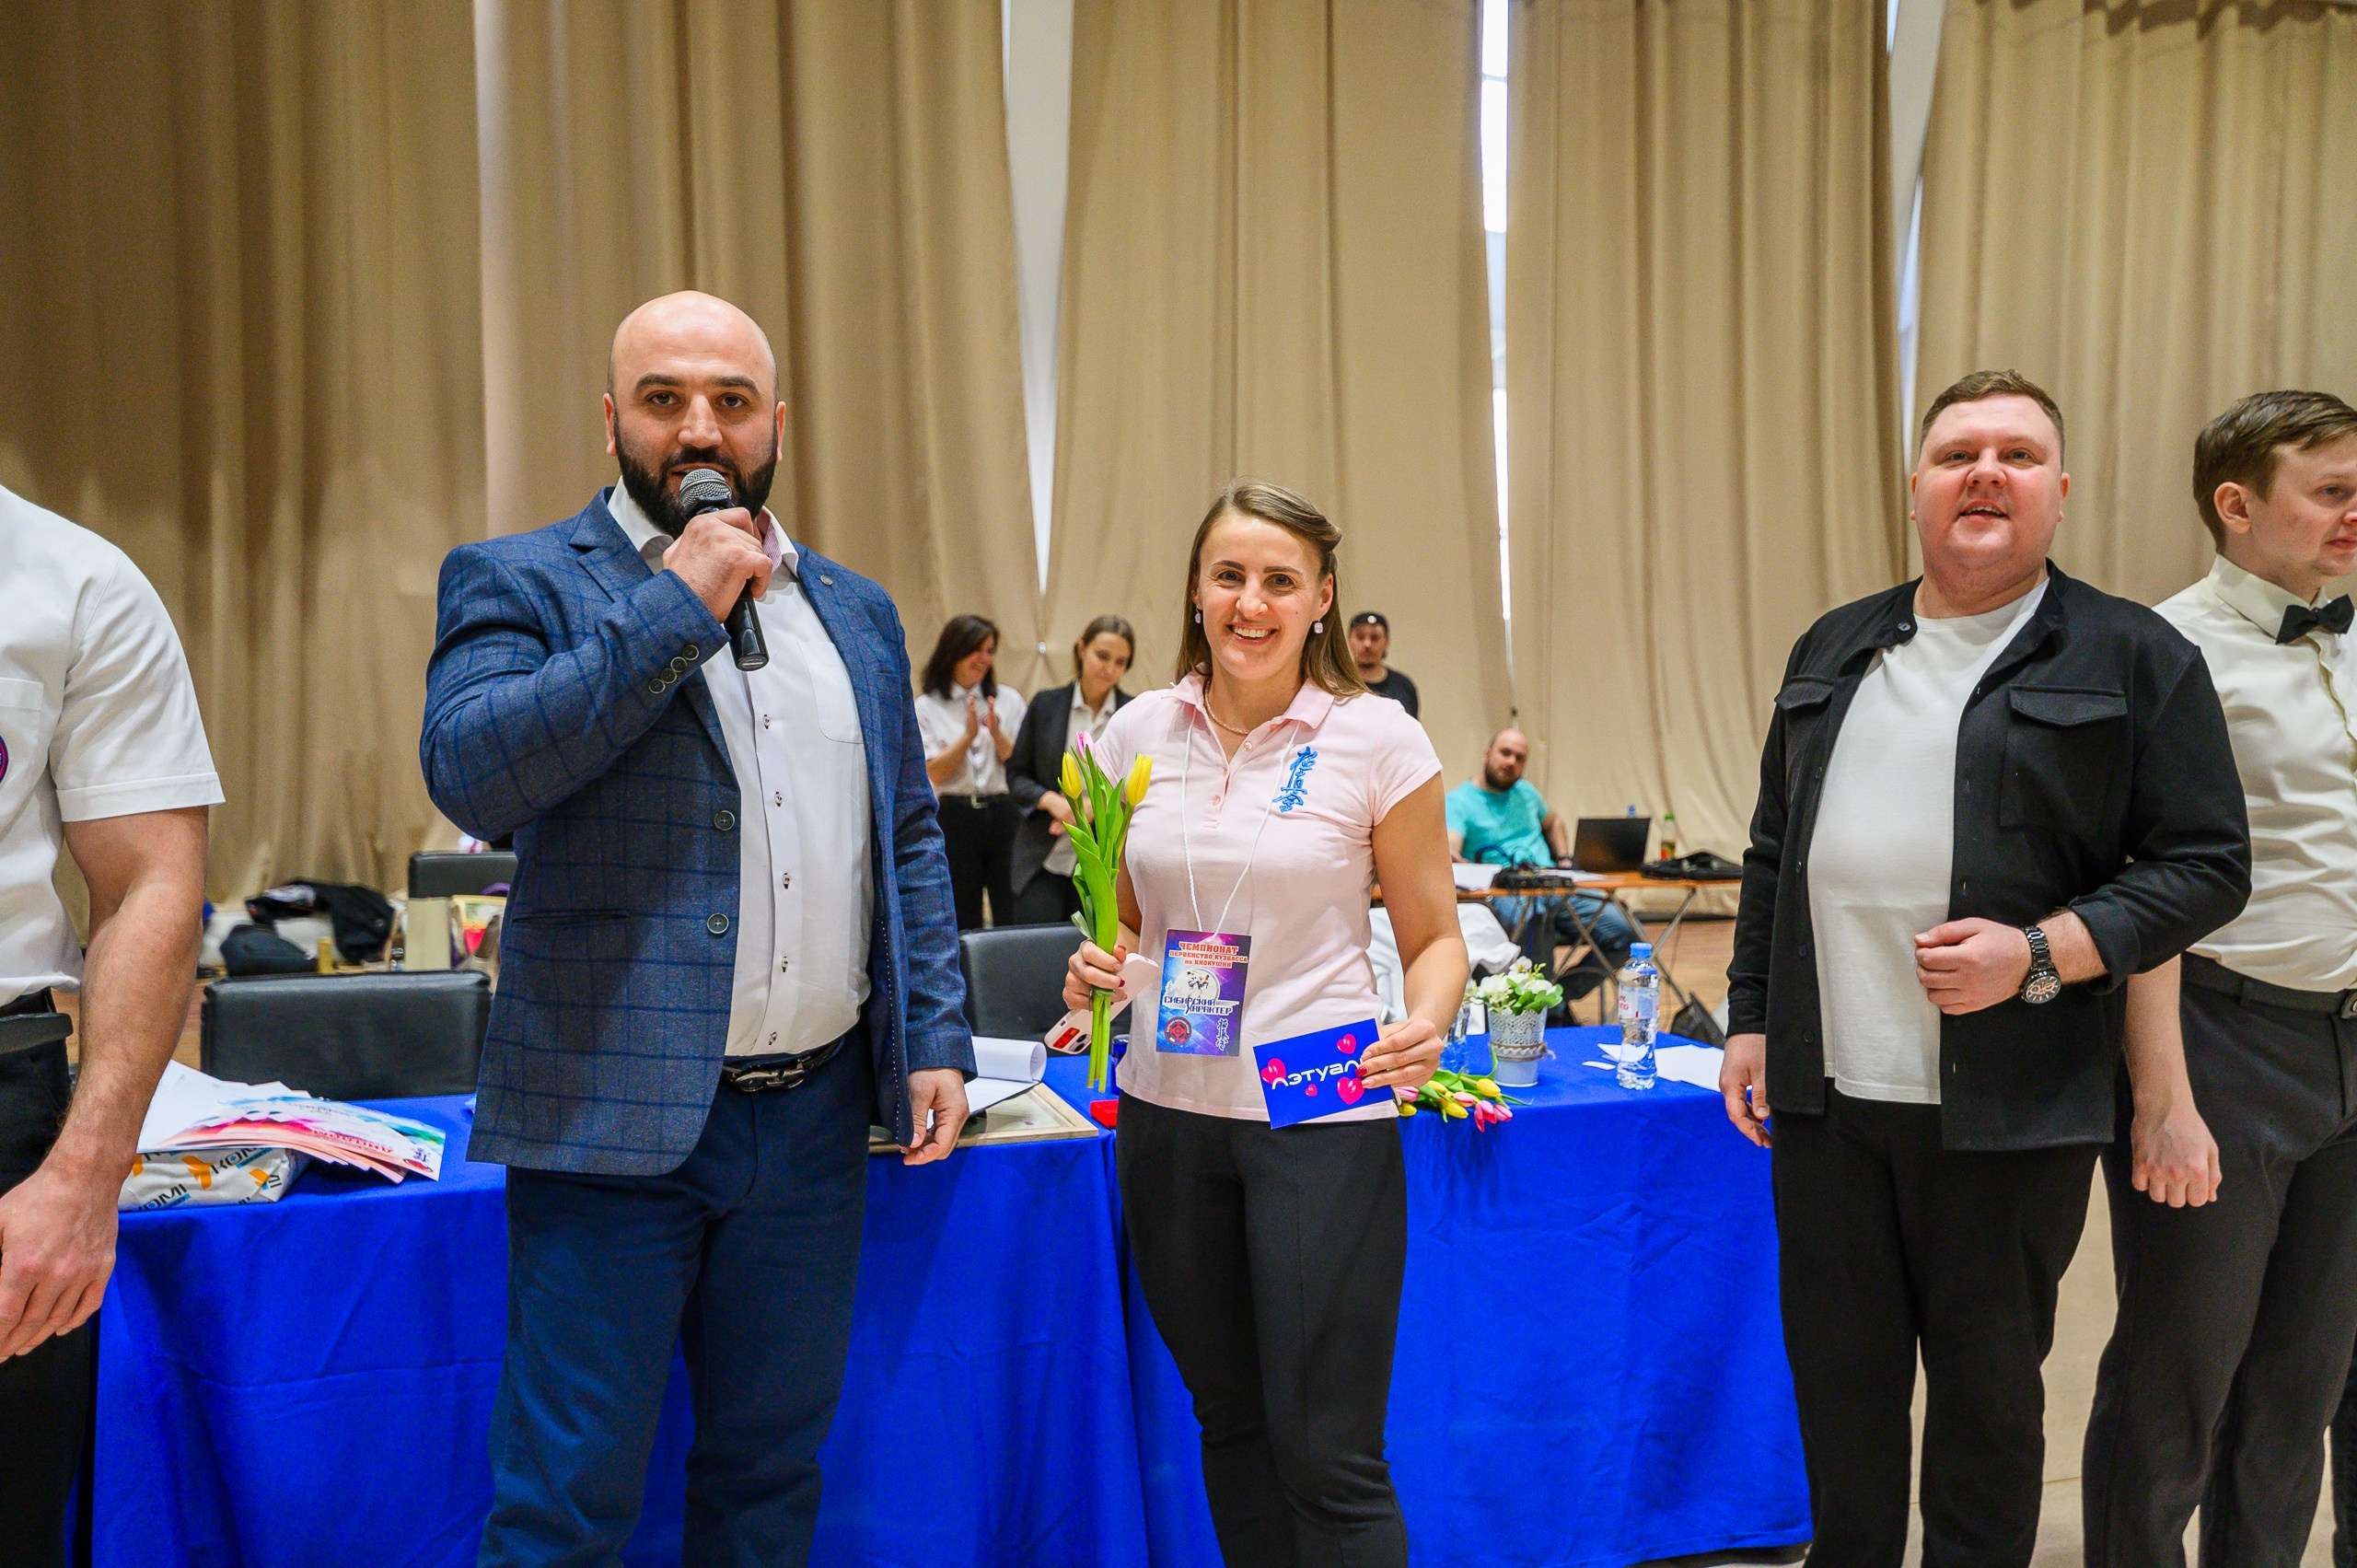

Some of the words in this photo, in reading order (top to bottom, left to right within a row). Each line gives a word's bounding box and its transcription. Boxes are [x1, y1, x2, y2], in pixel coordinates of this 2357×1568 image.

[1179, 942, 1238, 954] ЧЕМПИОНАТ
[1169, 950, 1213, 959] ПЕРВЕНСТВО
[1214, 954, 1248, 962] КУЗБАССА
[1185, 1005, 1232, 1015] ХАРАКТЕР
